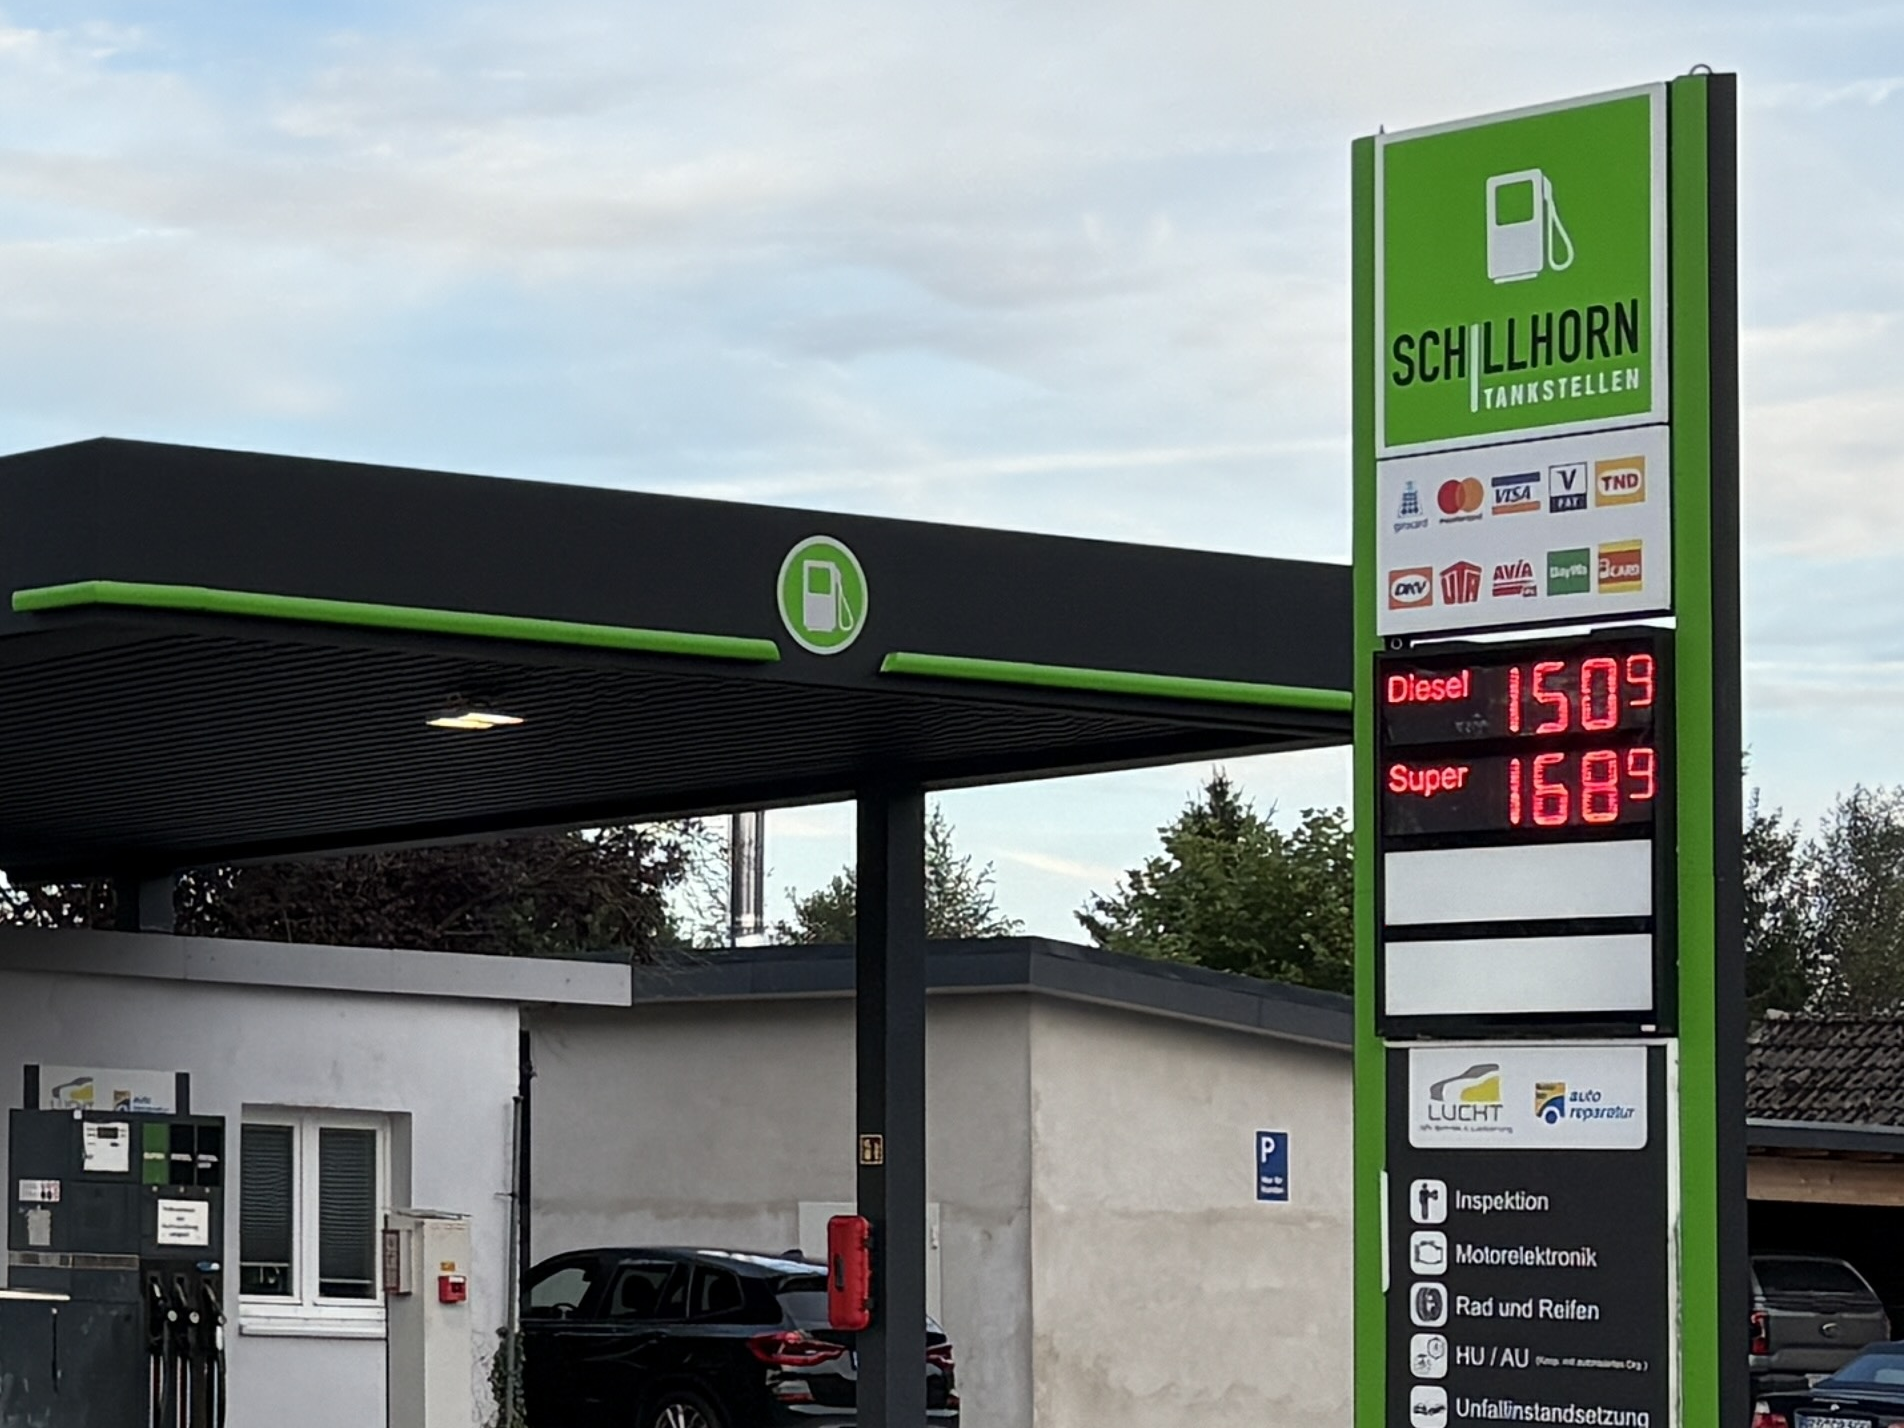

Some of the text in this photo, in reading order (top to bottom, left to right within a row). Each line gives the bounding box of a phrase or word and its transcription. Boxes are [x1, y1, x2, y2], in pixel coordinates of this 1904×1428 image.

[1392, 298, 1639, 412] SCHILLHORN
[1484, 368, 1639, 410] TANKSTELLEN
[1556, 468, 1576, 491] V
[1601, 473, 1639, 491] TND
[1494, 485, 1531, 503] VISA
[1387, 669, 1469, 703] Diesel
[1389, 764, 1469, 797] Super
[1569, 1089, 1602, 1103] auto
[1428, 1104, 1503, 1121] LUCHT
[1261, 1136, 1275, 1163] P
[1455, 1190, 1549, 1214] Inspektion
[1455, 1244, 1597, 1267] Motorelektronik
[1456, 1296, 1600, 1320] Rad und Reifen
[1456, 1346, 1485, 1366] HU
[1500, 1348, 1529, 1368] AU
